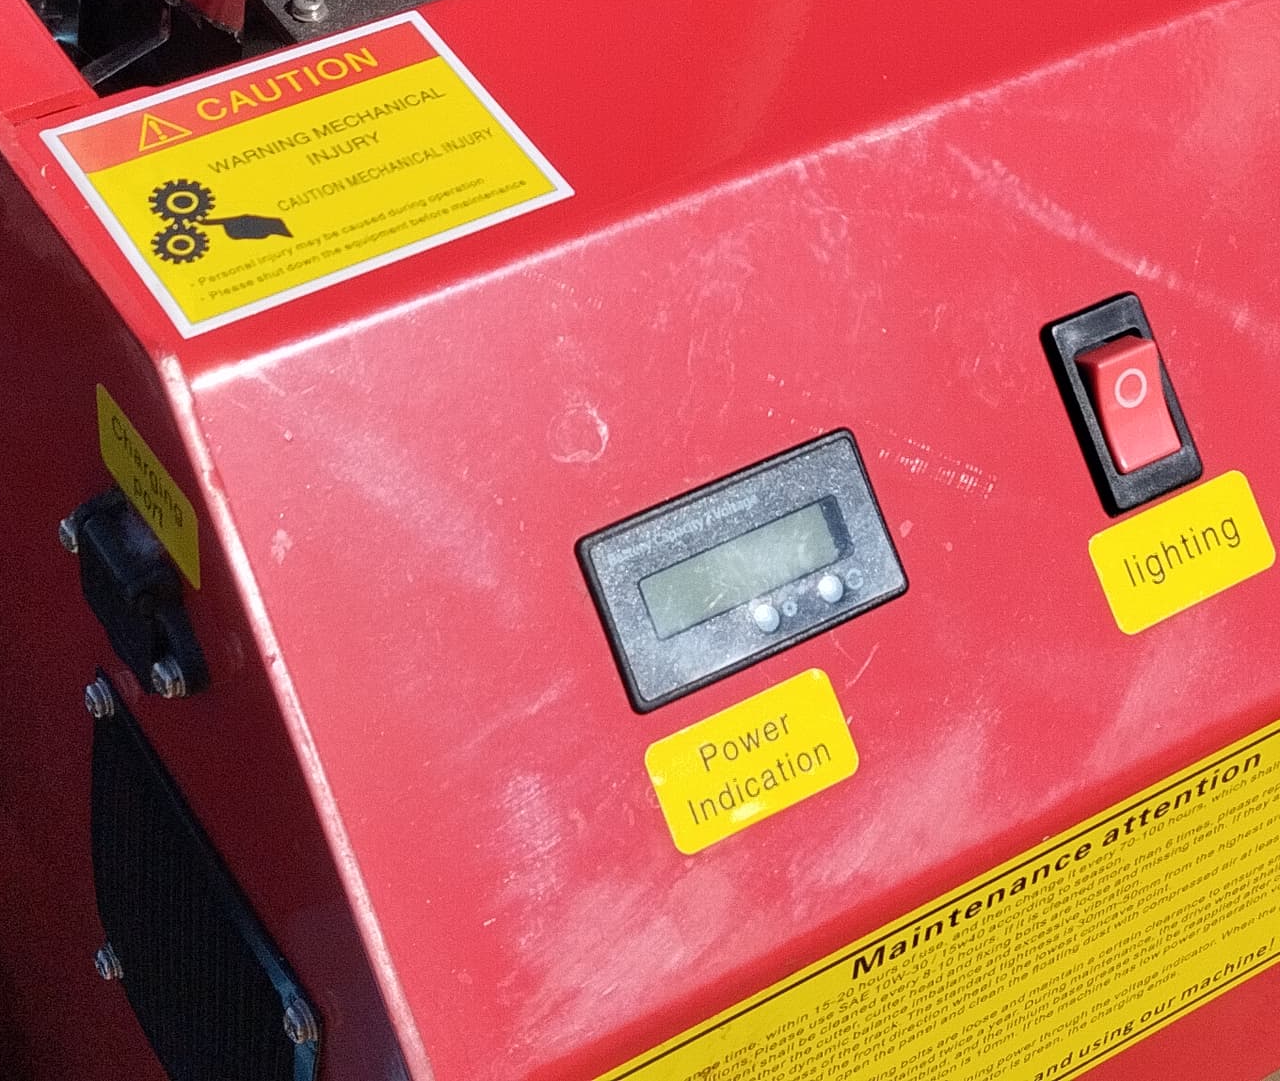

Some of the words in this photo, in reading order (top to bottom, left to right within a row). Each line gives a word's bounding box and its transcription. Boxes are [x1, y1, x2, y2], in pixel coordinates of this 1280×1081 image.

[189, 45, 382, 125] CAUTION
[206, 130, 313, 176] WARNING
[310, 84, 447, 140] MECHANICAL
[273, 179, 347, 213] CAUTION
[343, 145, 444, 188] MECHANICAL
[439, 126, 497, 154] INJURY
[303, 130, 385, 167] INJURY
[195, 258, 258, 287] Personal
[293, 235, 325, 253] may
[320, 228, 340, 241] be
[338, 211, 387, 235] caused
[385, 196, 429, 219] during
[425, 176, 487, 204] operation
[206, 276, 255, 300] Please
[252, 265, 286, 283] shut
[282, 252, 321, 272] down
[318, 244, 344, 259] the
[341, 220, 411, 252] equipment
[407, 205, 452, 227] before
[448, 177, 529, 212] maintenance
[1123, 517, 1241, 587] lighting
[688, 742, 832, 825] Indication
[699, 713, 789, 772] Power
[848, 833, 1096, 983] Maintenance
[1099, 744, 1265, 849] attention
[758, 1039, 796, 1069] shall
[796, 1028, 818, 1048] be
[818, 995, 878, 1037] cleaned
[878, 975, 919, 1006] every
[920, 954, 955, 982] 8-10
[1002, 923, 1014, 938] If
[1014, 917, 1026, 931] it
[1026, 909, 1040, 925] is
[1040, 879, 1095, 918] cleaned
[1096, 862, 1131, 888] more
[1132, 843, 1163, 869] than
[764, 1008, 811, 1042] within
[813, 984, 857, 1016] 15-20
[856, 961, 900, 993] hours
[900, 952, 917, 970] of
[951, 919, 979, 943] and
[979, 901, 1013, 928] then
[1012, 873, 1066, 912] change
[1066, 867, 1077, 882] it
[1076, 848, 1116, 878] every
[1118, 820, 1166, 854] 70-100
[788, 1041, 814, 1064] the
[863, 992, 906, 1024] cutter
[907, 971, 945, 1000] head
[945, 955, 974, 980] and
[974, 934, 1013, 966] fixing
[1013, 915, 1048, 943] bolts
[1049, 904, 1072, 924] are
[1073, 881, 1112, 911] loose
[1112, 867, 1139, 890] and
[1138, 839, 1191, 877] missing
[807, 1008, 835, 1031] use
[837, 988, 870, 1015] SAE
[874, 956, 930, 995] 10W-30
[940, 926, 986, 960] 15w40
[986, 888, 1056, 936] according
[1056, 880, 1072, 897] to
[872, 1040, 897, 1063] the
[896, 1018, 938, 1051] panel
[939, 1003, 966, 1026] and
[967, 981, 1006, 1011] clean
[1006, 968, 1030, 989] the
[1029, 940, 1081, 978] floating
[1081, 923, 1112, 948] dust
[1112, 907, 1141, 931] with
[788, 1032, 850, 1077] dynamic
[851, 1000, 909, 1041] balance
[910, 960, 984, 1009] imbalance
[984, 945, 1012, 969] and
[1012, 908, 1081, 954] excessive
[820, 1051, 837, 1069] of
[835, 1038, 862, 1061] the
[905, 998, 934, 1023] The
[934, 964, 997, 1007] standard
[997, 929, 1061, 975] tightness
[1061, 922, 1075, 938] is
[825, 1055, 851, 1078] the
[851, 1035, 887, 1064] front
[887, 1001, 950, 1044] direction
[950, 977, 993, 1009] wheel
[993, 968, 1009, 986] to
[1009, 955, 1033, 977] the
[1033, 930, 1079, 964] lowest
[1078, 901, 1135, 939] concave
[899, 1041, 935, 1070] bolts
[935, 1029, 960, 1050] are
[959, 1006, 999, 1036] loose
[999, 991, 1027, 1014] and
[1027, 958, 1085, 999] maintain
[1097, 927, 1143, 961] certain
[937, 1030, 975, 1059] twice
[1021, 978, 1068, 1014] During
[953, 1037, 981, 1061] and
[980, 1024, 1004, 1046] the
[1004, 998, 1051, 1032] lithium
[1050, 979, 1085, 1007] base
[1084, 956, 1131, 990] grease
[959, 1051, 973, 1068] is
[1020, 1018, 1032, 1033] If
[1032, 1005, 1055, 1027] the
[1055, 974, 1112, 1014] machine
[995, 1038, 1036, 1070] power
[1037, 1007, 1090, 1046] through
[1089, 994, 1112, 1015] the
[1111, 967, 1160, 1004] voltage
[1008, 1055, 1022, 1071] is
[1065, 1017, 1089, 1039] the
[1088, 985, 1146, 1028] charging
[1030, 1049, 1075, 1081] and
[1076, 1014, 1137, 1062] using
[1138, 993, 1177, 1026] our
[1179, 934, 1277, 1003] machine!
